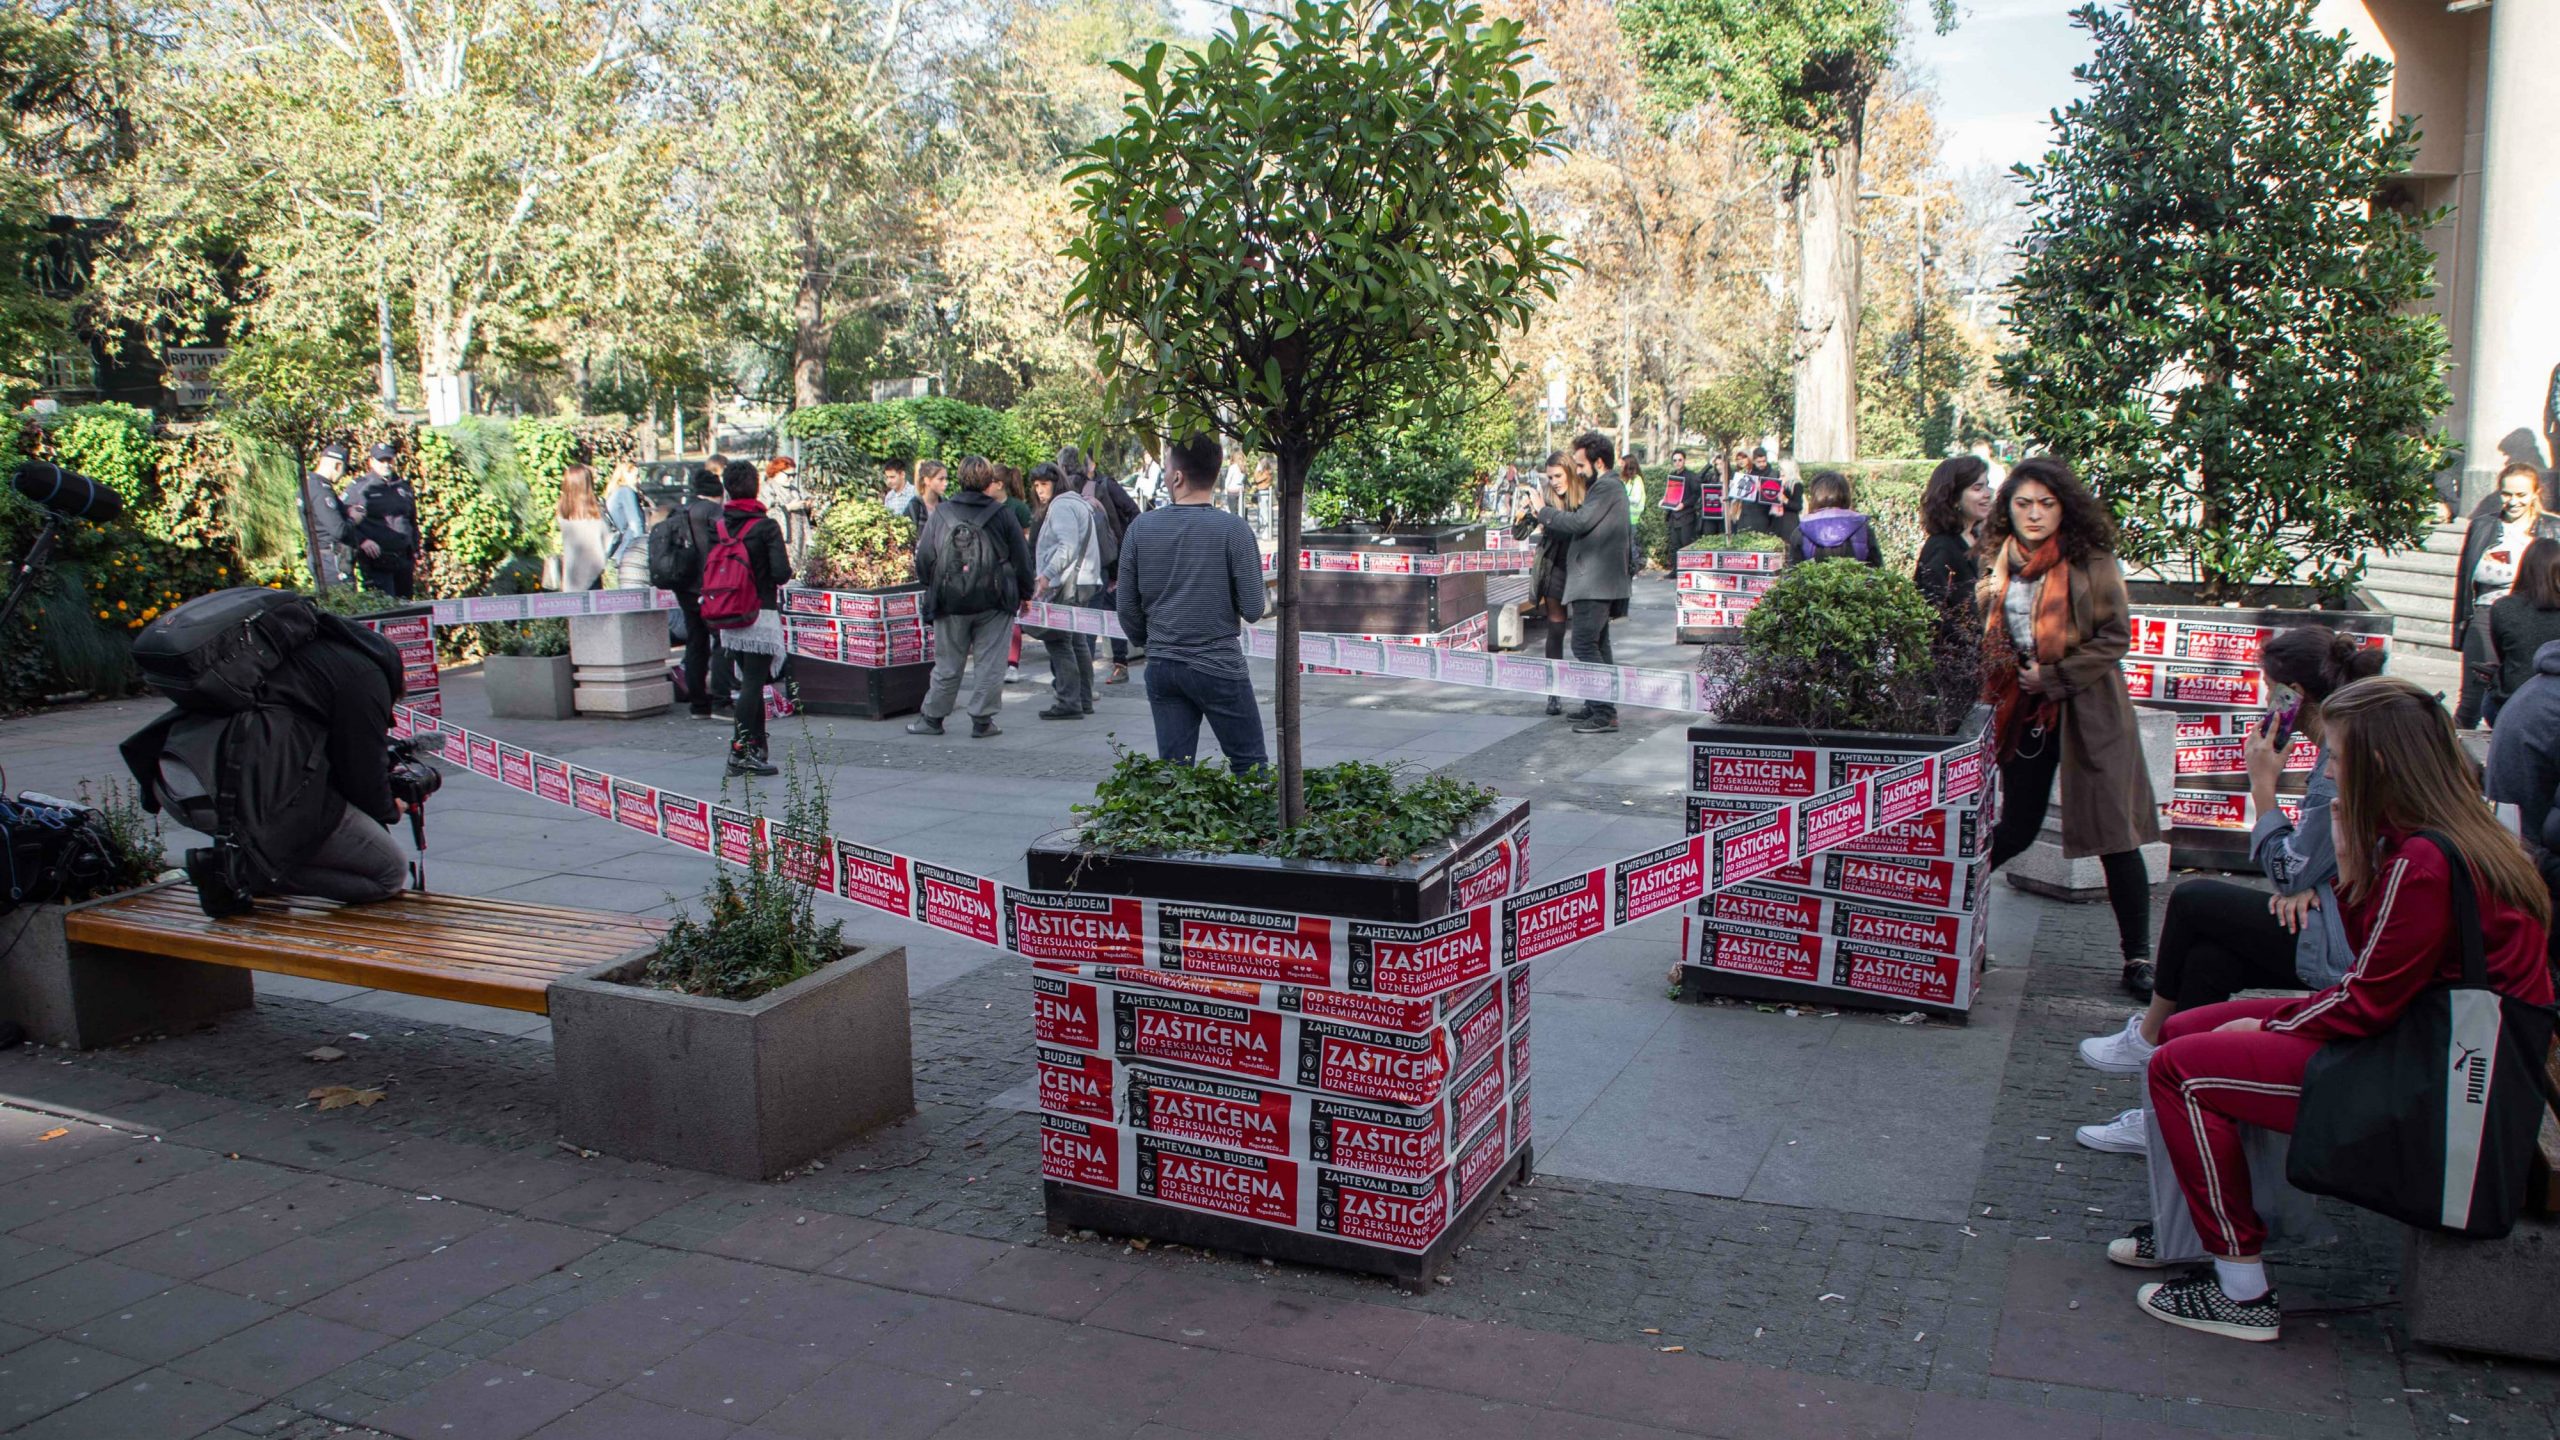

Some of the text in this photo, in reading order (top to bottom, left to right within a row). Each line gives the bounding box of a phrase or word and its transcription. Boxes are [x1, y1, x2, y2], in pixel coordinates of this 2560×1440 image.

[2179, 678, 2252, 692] ZAŠTIĆENA
[1699, 748, 1742, 756] ZAHTEVAM
[1760, 750, 1789, 758] BUDEM
[2179, 748, 2242, 761] ZAŠTIĆEN
[1714, 761, 1806, 780] ZAŠTIĆENA
[1728, 777, 1780, 787] SEKSUALNOG
[1713, 784, 1780, 794] UZNEMIRAVANJA
[1801, 787, 1853, 812] ZAHTEVAM DA BUDEM
[1883, 777, 1929, 805] ZAŠTIĆENA
[1716, 813, 1775, 840] ZAHTEVAM DA BUDEM
[1810, 801, 1861, 832] ZAŠTIĆENA
[840, 843, 891, 864] ZAHTEVAM DA BUDEM
[1726, 829, 1785, 862] ZAŠTIĆENA
[1619, 843, 1686, 873] ZAHTEVAM DA BUDEM
[1726, 852, 1769, 872] OD SEKSUALNOG
[851, 863, 905, 894] ZAŠTIĆENA
[917, 865, 976, 888] ZAHTEVAM DA BUDEM
[1631, 859, 1698, 897] ZAŠTIĆENA
[1725, 861, 1768, 881] UZNEMIRAVANJA
[1846, 863, 1942, 890] ZAŠTIĆENA
[929, 885, 991, 919] ZAŠTIĆENA
[1006, 889, 1105, 909] ZAHTEVAM DA BUDEM
[1507, 879, 1584, 911] ZAHTEVAM DA BUDEM
[1630, 883, 1680, 907] OD SEKSUALNOG
[1630, 894, 1679, 917] UZNEMIRAVANJA
[929, 904, 973, 925] OD SEKSUALNOG
[929, 914, 973, 934] UZNEMIRAVANJA
[1165, 906, 1291, 928] ZAHTEVAM DA BUDEM
[1521, 894, 1598, 935] ZAŠTIĆENA
[1719, 899, 1809, 925] ZAŠTIĆENA
[1020, 912, 1130, 941] ZAŠTIĆENA
[1356, 917, 1466, 941] ZAHTEVAM DA BUDEM
[1520, 920, 1577, 947] OD SEKSUALNOG
[1708, 922, 1751, 934] ZAHTEVAM
[1768, 931, 1797, 941] BUDEM
[1854, 919, 1947, 945] ZAŠTIĆENA
[1021, 934, 1097, 949] OD SEKSUALNOG
[1021, 944, 1097, 959] UZNEMIRAVANJA
[1188, 928, 1317, 960] ZAŠTIĆENA
[1380, 933, 1482, 971] ZAŠTIĆENA
[1520, 931, 1576, 957] UZNEMIRAVANJA
[1719, 938, 1811, 963] ZAŠTIĆENA
[1842, 943, 1934, 963] ZAHTEVAM DA BUDEM
[1188, 950, 1280, 968] OD SEKSUALNOG
[1188, 960, 1280, 977] UZNEMIRAVANJA
[1121, 969, 1210, 993] UZNEMIRAVANJA
[1379, 962, 1458, 984] OD SEKSUALNOG
[1379, 973, 1458, 995] UZNEMIRAVANJA
[1854, 958, 1947, 986] ZAŠTIĆENA
[1120, 995, 1244, 1019] ZAHTEVAM DA BUDEM
[1307, 1003, 1403, 1027] UZNEMIRAVANJA
[1308, 992, 1404, 1016] OD SEKSUALNOG
[1143, 1016, 1268, 1052] ZAŠTIĆENA
[1308, 1022, 1429, 1050] ZAHTEVAM DA BUDEM
[1462, 1006, 1500, 1051] ZAŠTIĆENA
[1141, 1037, 1233, 1057] OD SEKSUALNOG
[1141, 1046, 1231, 1067] UZNEMIRAVANJA
[1329, 1046, 1442, 1080] ZAŠTIĆENA
[1137, 1072, 1257, 1100] ZAHTEVAM DA BUDEM
[1326, 1067, 1423, 1092] OD SEKSUALNOG
[1326, 1080, 1421, 1102] UZNEMIRAVANJA
[2467, 1057, 2486, 1104] PUMA
[1461, 1069, 1501, 1119] ZAŠTIĆENA
[1153, 1115, 1242, 1138] OD SEKSUALNOG
[1154, 1096, 1277, 1134] ZAŠTIĆENA
[1319, 1103, 1433, 1128] ZAHTEVAM DA BUDEM
[1154, 1125, 1241, 1148] UZNEMIRAVANJA
[1336, 1127, 1440, 1157] ZAŠTIĆENA
[1144, 1137, 1264, 1168] ZAHTEVAM DA BUDEM
[1336, 1147, 1427, 1169] OD SEKSUALNOG
[1461, 1130, 1502, 1184] ZAŠTIĆENA
[1162, 1159, 1284, 1200] ZAŠTIĆENA
[1336, 1158, 1427, 1179] UZNEMIRAVANJA
[1161, 1179, 1250, 1204] OD SEKSUALNOG
[1325, 1171, 1435, 1195] ZAHTEVAM DA BUDEM
[1161, 1190, 1249, 1214] UZNEMIRAVANJA
[1344, 1192, 1443, 1225] ZAŠTIĆENA
[1343, 1215, 1430, 1236] OD SEKSUALNOG
[1343, 1225, 1428, 1247] UZNEMIRAVANJA
